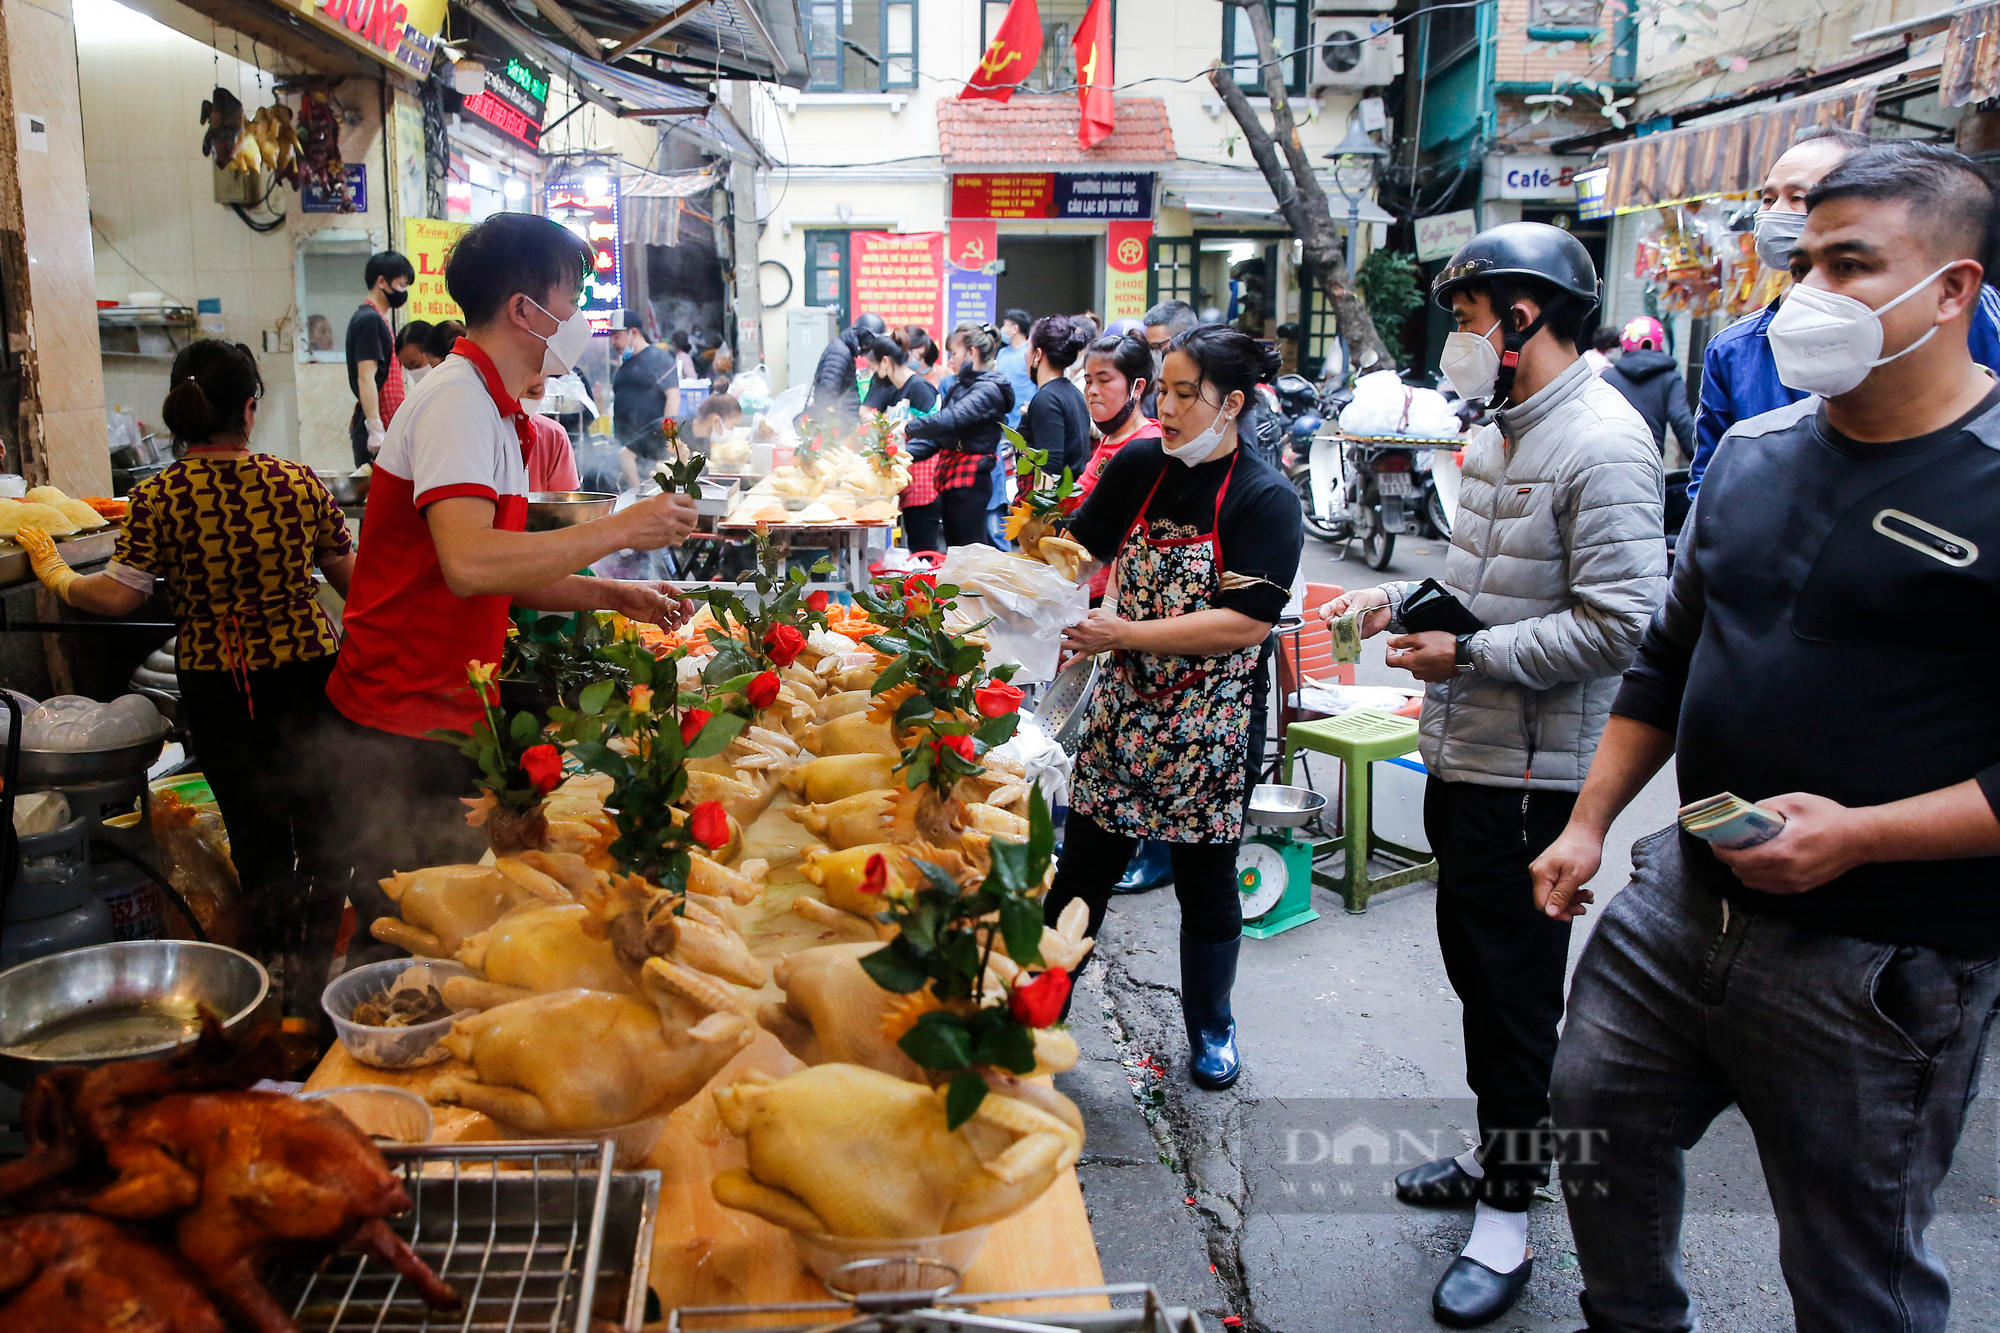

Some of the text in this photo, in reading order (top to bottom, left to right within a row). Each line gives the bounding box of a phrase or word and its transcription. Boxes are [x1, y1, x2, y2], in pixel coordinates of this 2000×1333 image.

[1072, 179, 1101, 194] PHƯỜNG
[1102, 178, 1120, 194] HÀNG
[1507, 168, 1551, 188] Café
